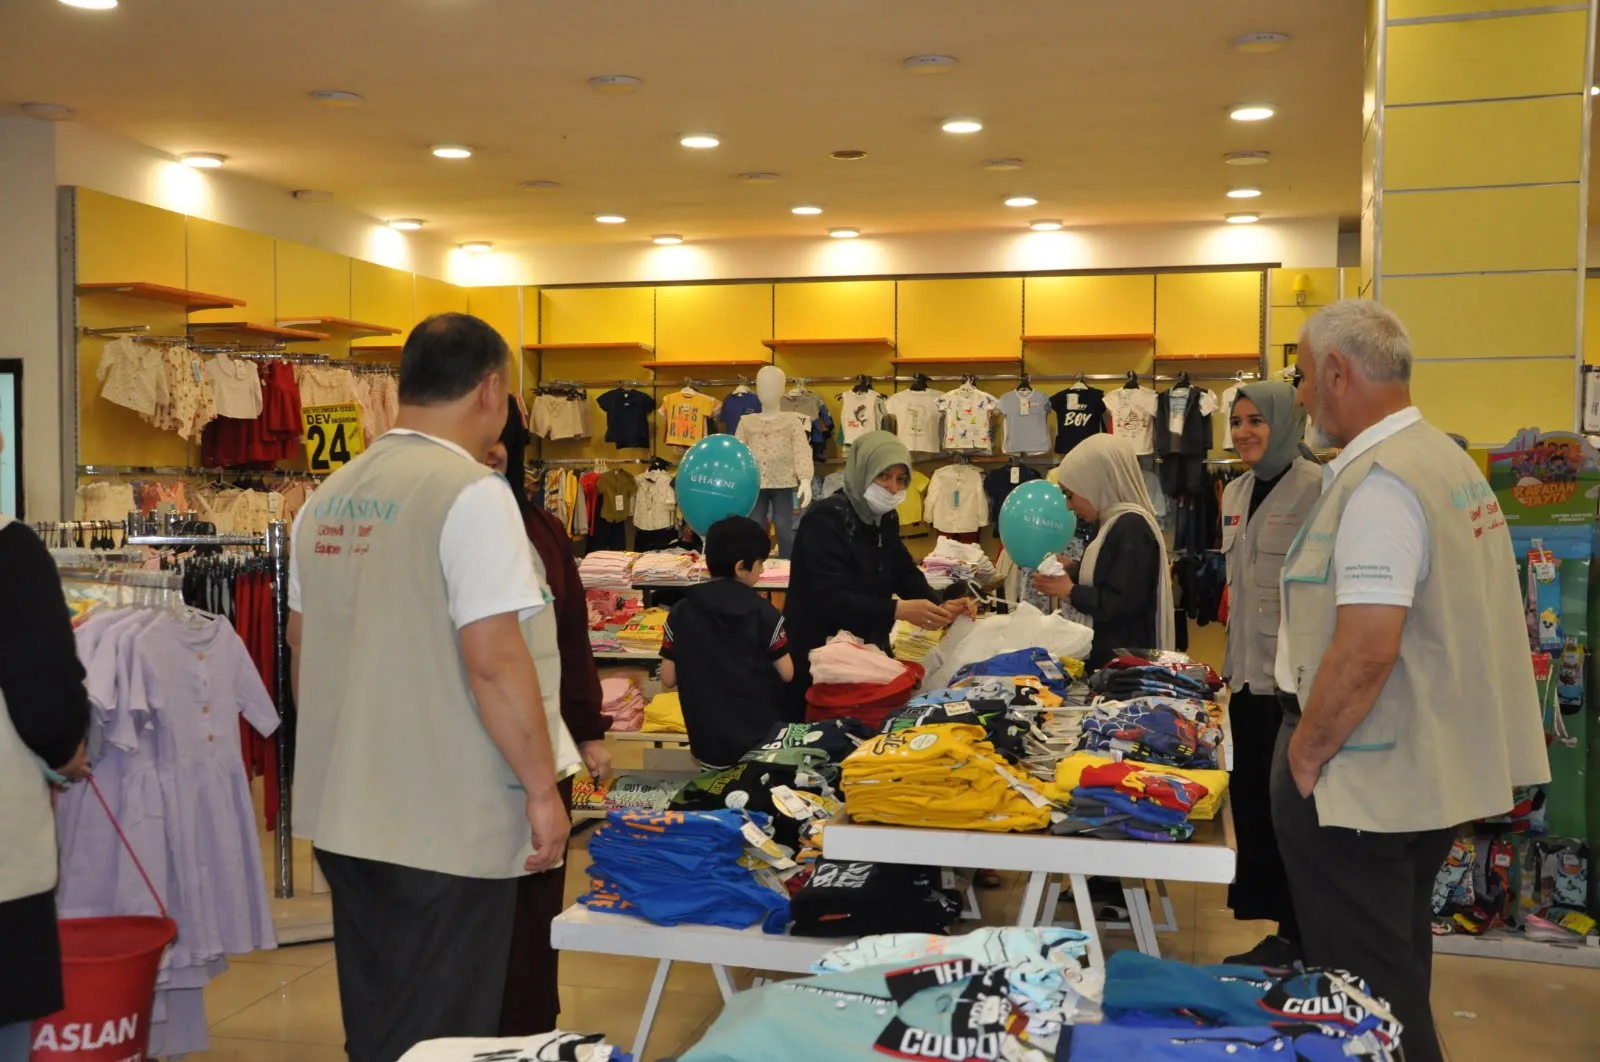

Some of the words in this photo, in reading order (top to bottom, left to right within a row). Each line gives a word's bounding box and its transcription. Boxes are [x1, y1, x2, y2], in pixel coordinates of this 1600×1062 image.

[306, 414, 331, 425] DEV
[1064, 411, 1092, 427] BOY
[307, 424, 351, 470] 24
[698, 475, 736, 489] HASENE
[1514, 483, 1576, 498] RAFADAN
[1526, 494, 1566, 507] TAYFA
[33, 1013, 138, 1051] ASLAN
